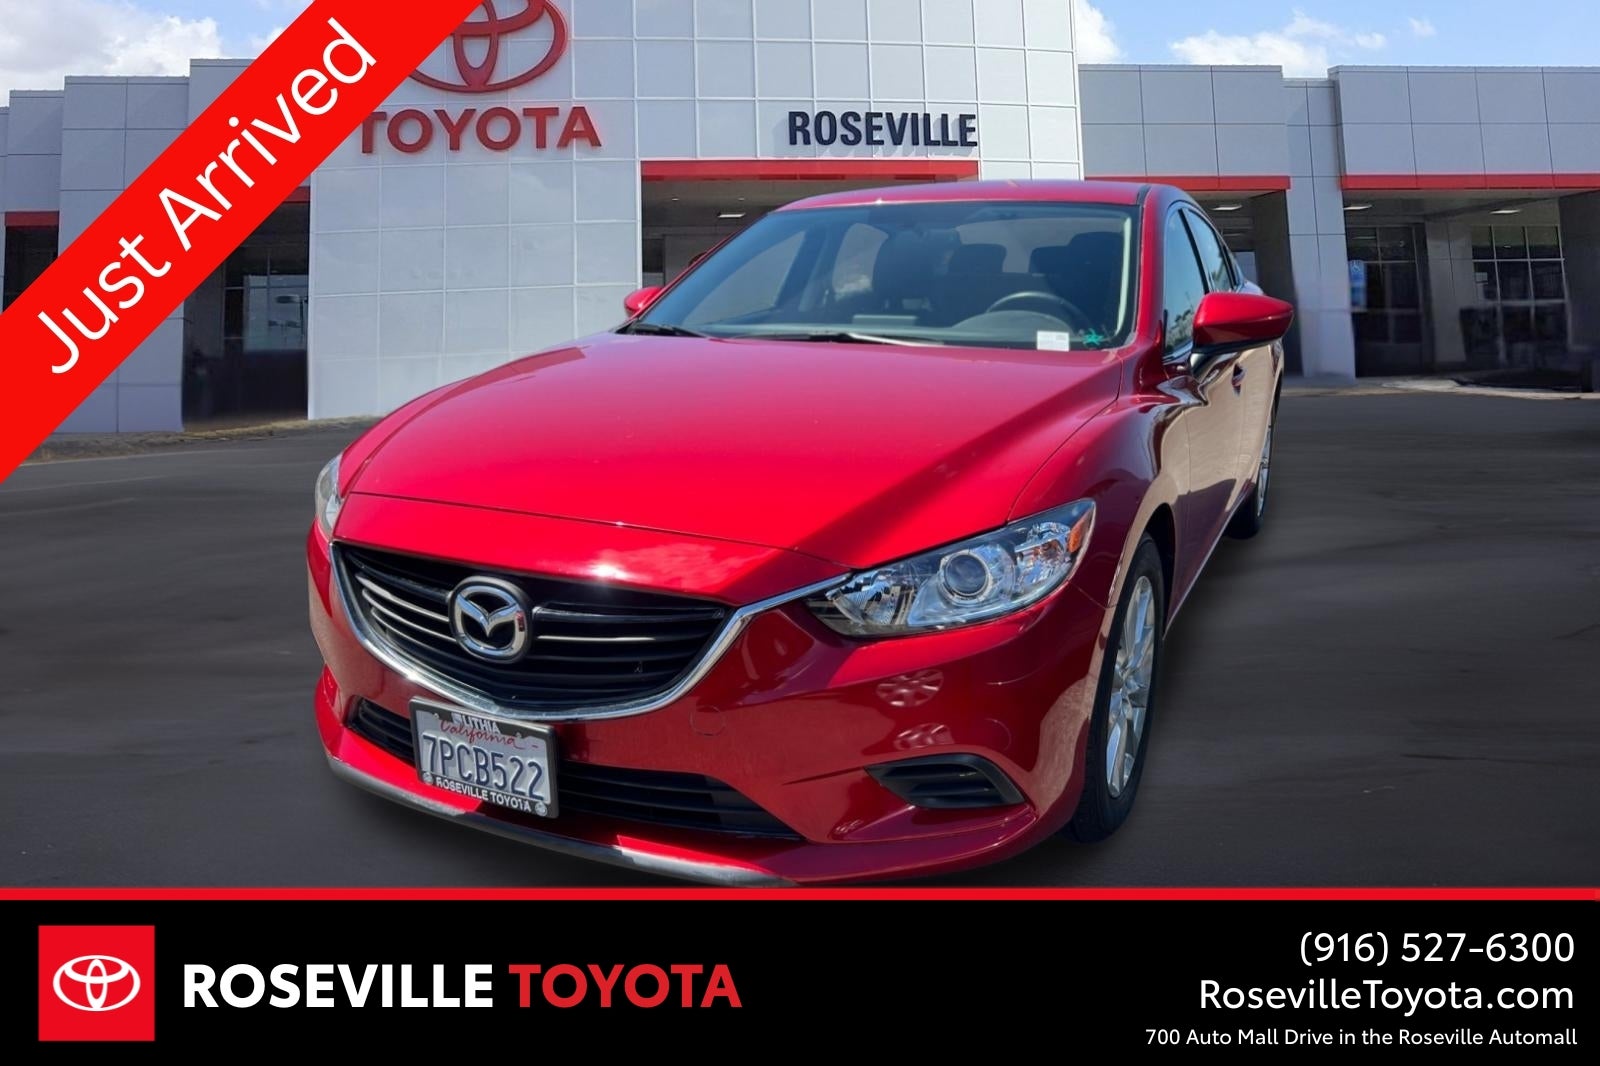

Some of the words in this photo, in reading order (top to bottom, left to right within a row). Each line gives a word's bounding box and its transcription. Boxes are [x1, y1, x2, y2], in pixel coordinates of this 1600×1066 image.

[362, 106, 602, 154] TOYOTA
[788, 110, 978, 147] ROSEVILLE
[461, 714, 501, 735] LITHIA
[423, 734, 544, 801] 7PCB522
[435, 777, 489, 801] ROSEVILLE
[490, 792, 532, 812] TOYOTA
